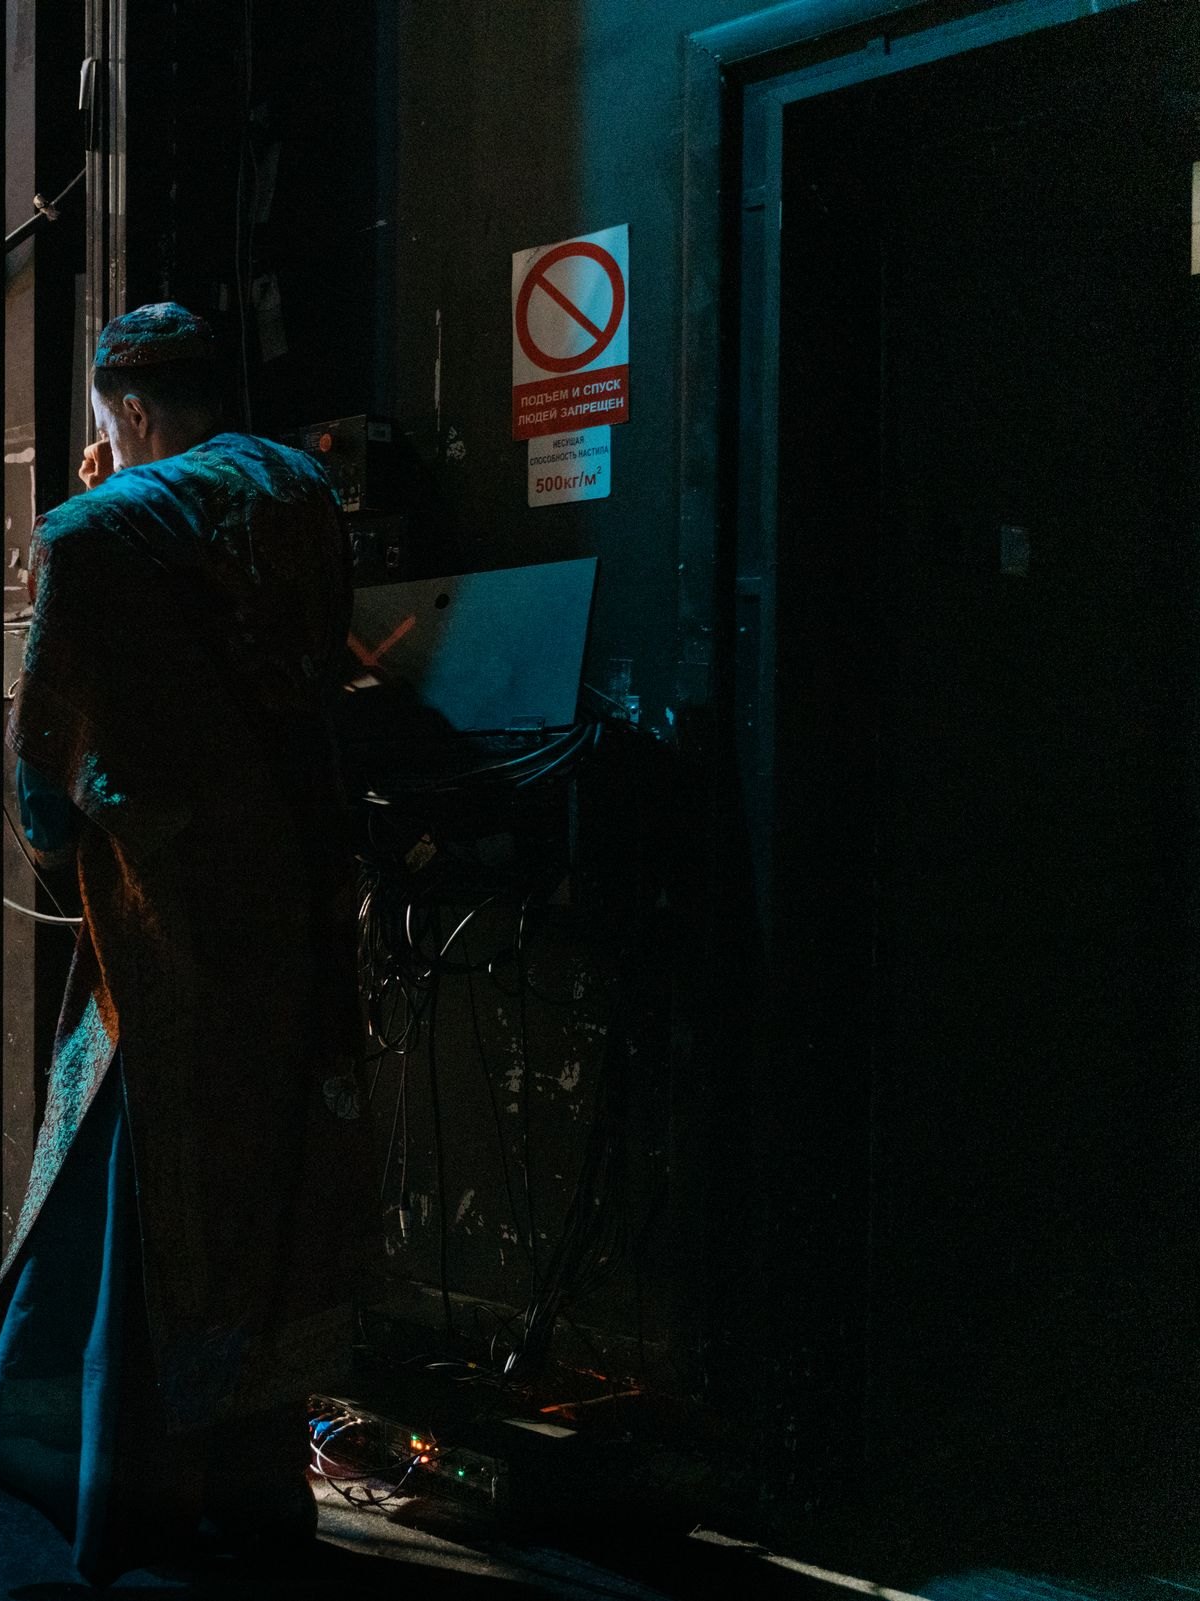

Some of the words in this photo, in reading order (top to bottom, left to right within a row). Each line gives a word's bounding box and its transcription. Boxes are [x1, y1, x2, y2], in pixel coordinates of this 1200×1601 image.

[520, 389, 569, 408] ПОДЪЕМ
[572, 387, 580, 398] И
[583, 379, 621, 396] СПУСК
[518, 408, 558, 426] ЛЮДЕЙ
[560, 397, 624, 418] ЗАПРЕЩЕН
[553, 436, 585, 449] НЕСУЩАЯ
[530, 452, 577, 466] СПОСОБНОСТЬ
[578, 445, 609, 458] НАСТИЛА
